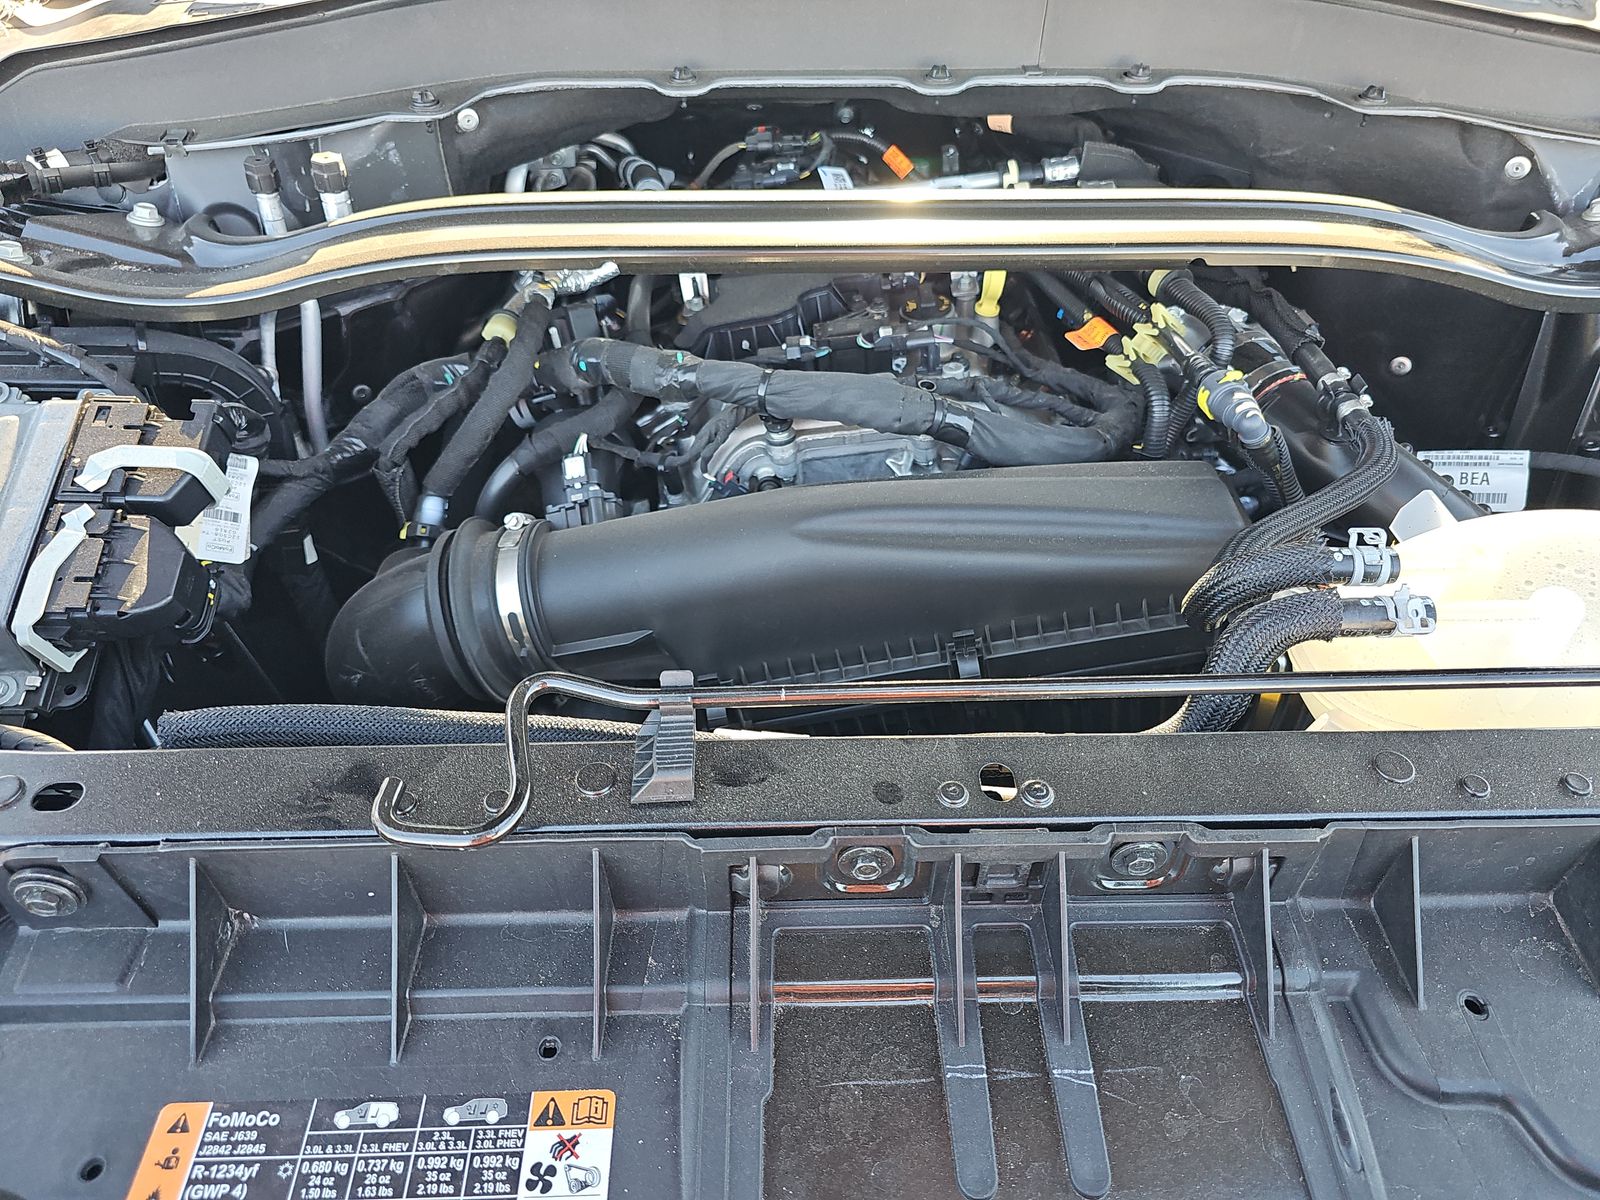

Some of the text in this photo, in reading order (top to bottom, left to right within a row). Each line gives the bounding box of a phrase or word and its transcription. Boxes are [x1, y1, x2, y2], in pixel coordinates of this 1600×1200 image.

[1460, 472, 1490, 486] BEA
[207, 1111, 280, 1128] FoMoCo
[204, 1131, 257, 1141] SAE J639
[477, 1129, 524, 1139] 3.3L FHEV
[305, 1144, 354, 1154] 3.0L & 3.3L
[362, 1143, 409, 1152] 3.3L FHEV
[418, 1141, 467, 1150] 3.0L & 3.3L
[475, 1139, 523, 1148] 3.0L PHEV
[198, 1144, 266, 1156] J2842 J2845
[357, 1159, 404, 1174] 0.737 kg
[417, 1156, 464, 1171] 0.992 kg
[473, 1155, 519, 1170] 0.992 kg
[190, 1164, 260, 1181] R-1234yf
[301, 1161, 349, 1176] 0.680 kg
[308, 1175, 335, 1186] 24 oz
[365, 1174, 391, 1184] 26 oz
[425, 1171, 451, 1181] 35 oz
[482, 1170, 507, 1180] 35 oz
[185, 1184, 247, 1200] (GWP 4)
[301, 1188, 337, 1199] 1.50 lbs
[357, 1186, 393, 1197] 1.63 lbs
[417, 1183, 454, 1195] 2.19 lbs
[473, 1182, 510, 1194] 2.19 lbs
